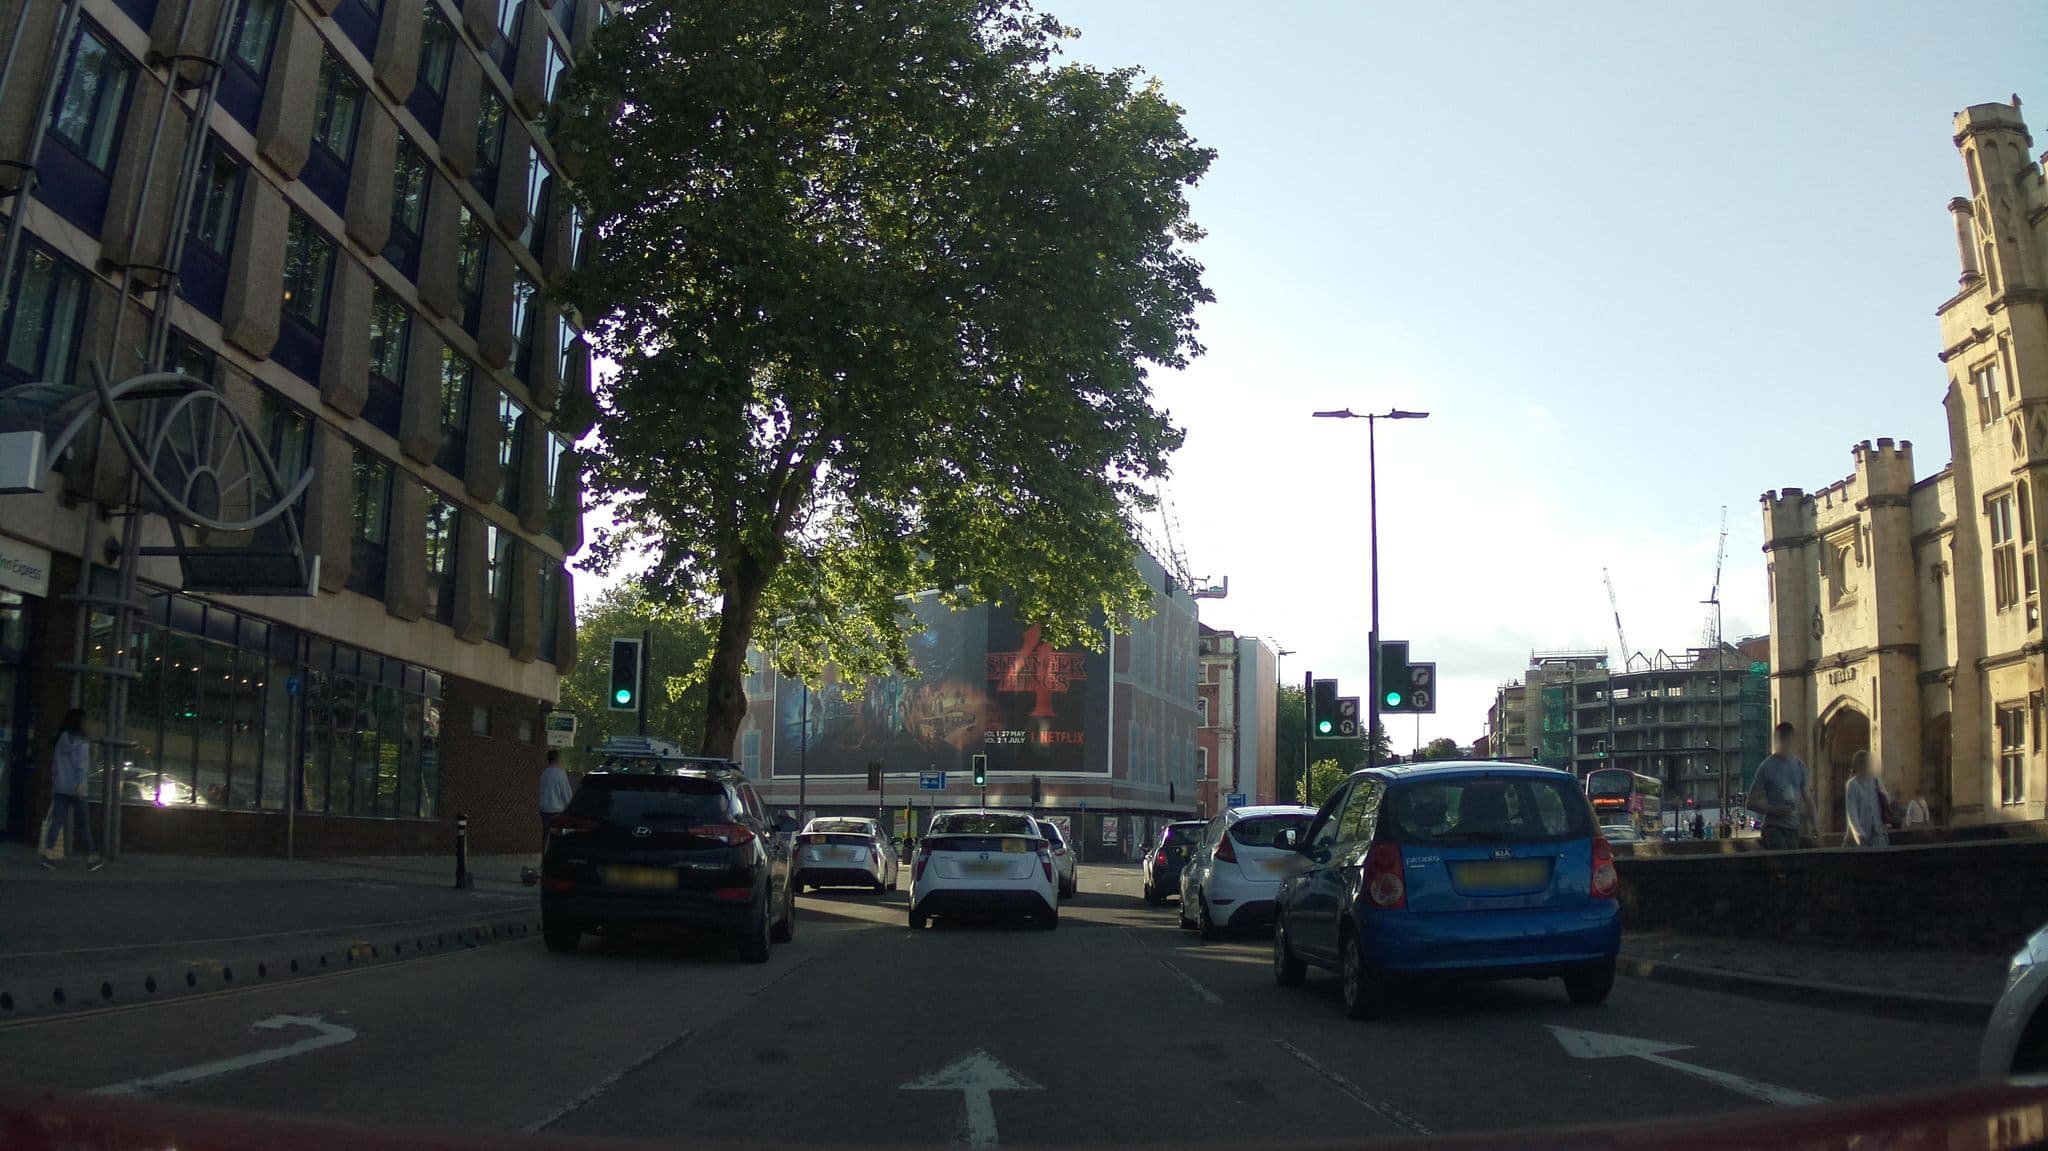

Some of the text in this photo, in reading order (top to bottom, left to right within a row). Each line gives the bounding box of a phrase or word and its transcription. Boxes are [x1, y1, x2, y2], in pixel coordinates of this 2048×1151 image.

[12, 559, 41, 580] Express
[985, 655, 1087, 679] STRANGER
[998, 674, 1069, 691] THINGS
[1040, 731, 1084, 744] NETFLIX
[1406, 855, 1440, 865] picanto
[1495, 849, 1511, 857] KIA
